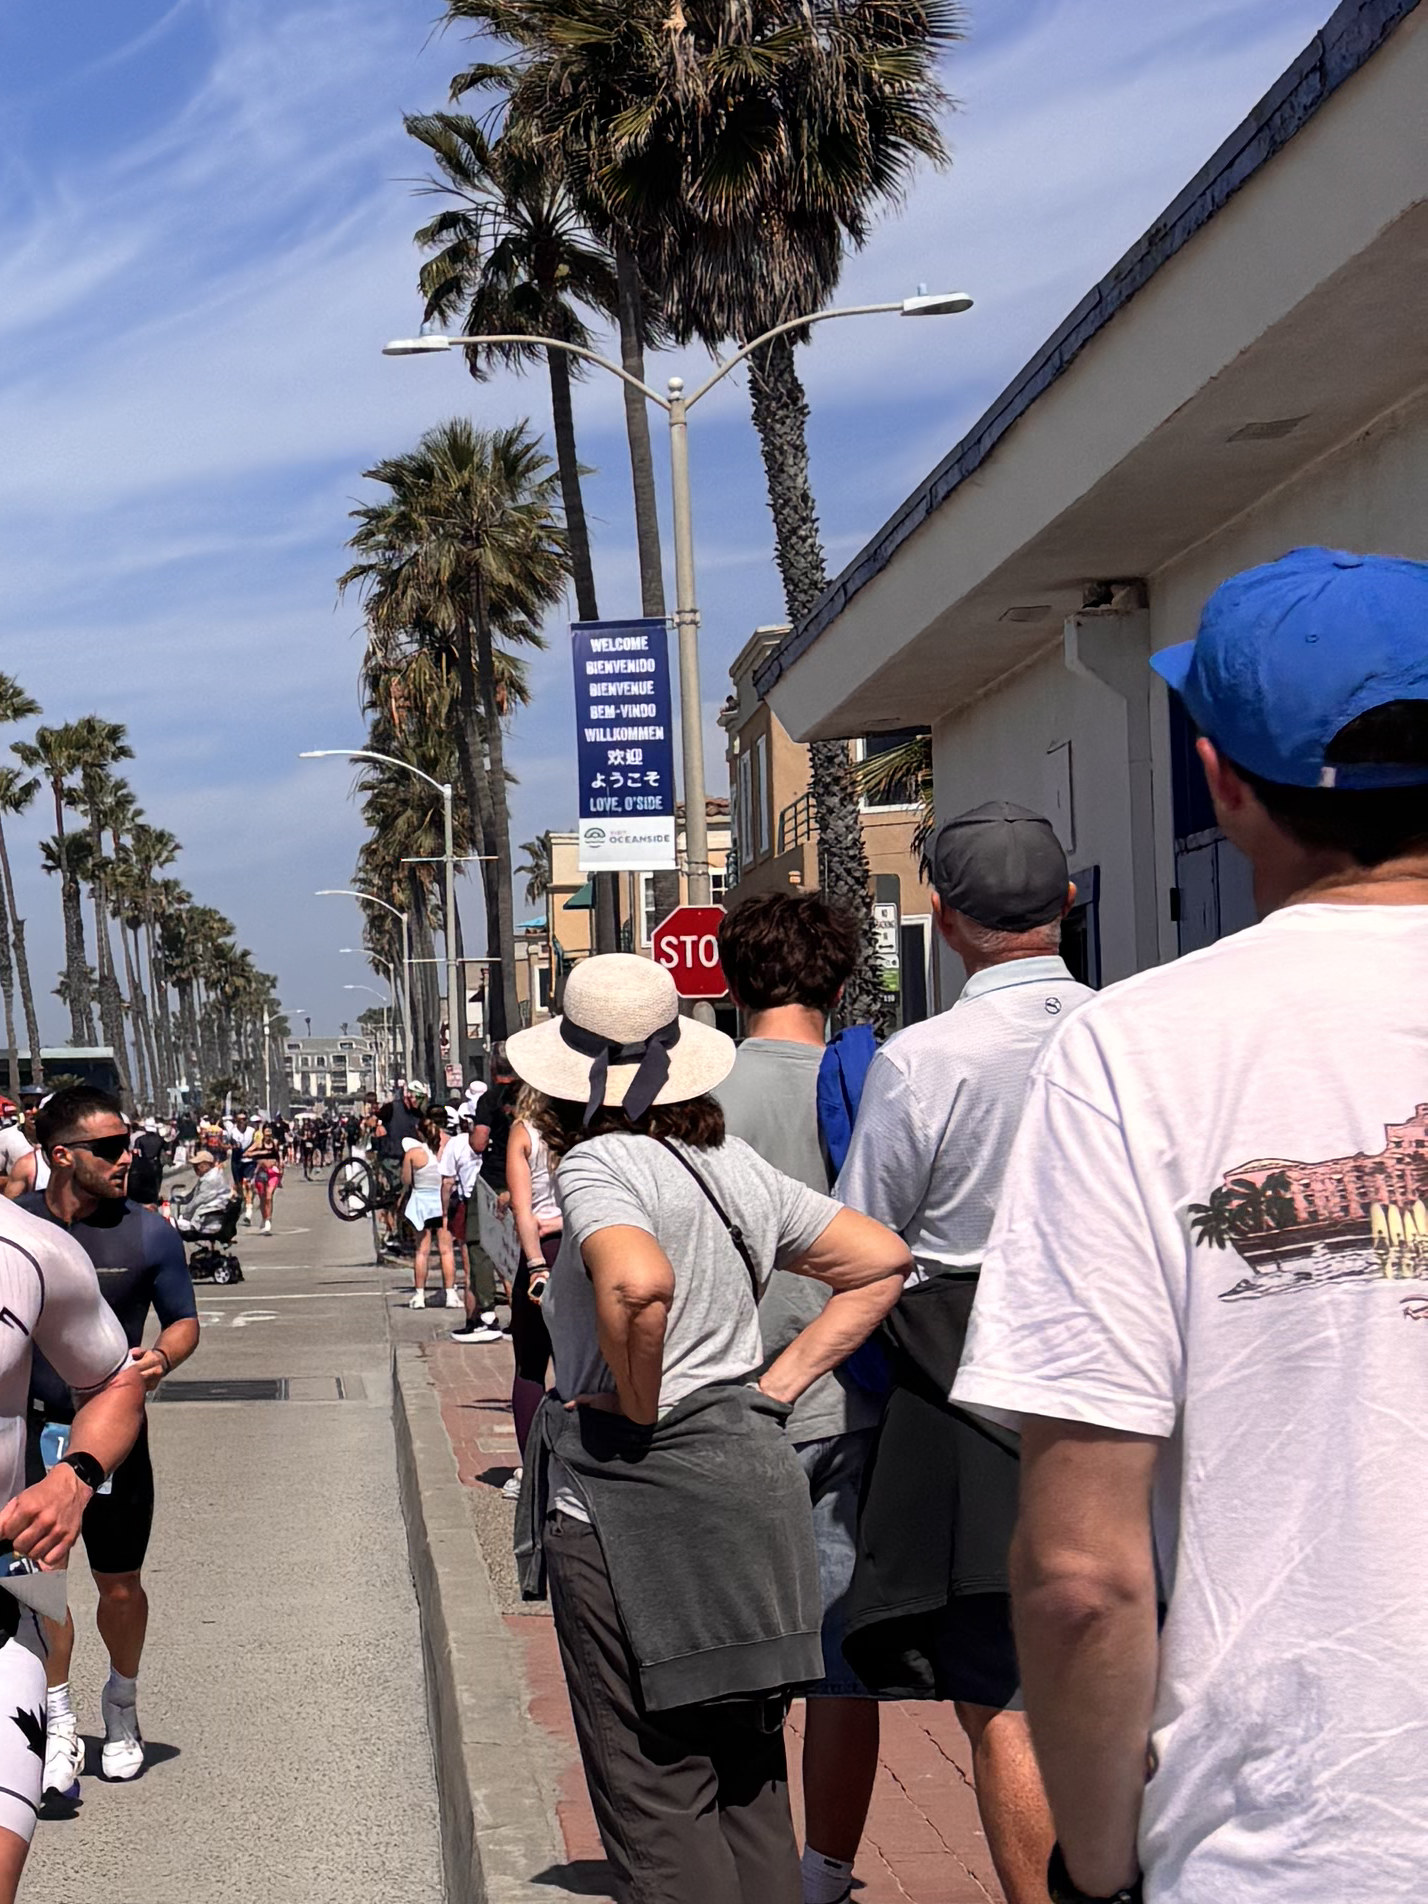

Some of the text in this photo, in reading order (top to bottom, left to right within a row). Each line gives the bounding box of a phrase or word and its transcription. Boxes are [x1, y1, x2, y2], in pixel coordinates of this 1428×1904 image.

[590, 636, 649, 653] WELCOME
[586, 658, 656, 675] BIENVENIDO
[589, 680, 655, 697] BIENVENUE
[590, 703, 657, 719] BEM-VINDO
[584, 726, 664, 742] WILLKOMMEN
[607, 748, 643, 765] 欢迎
[591, 771, 661, 789] ようこそ
[590, 796, 663, 812] LOVE, O'SIDE
[609, 834, 671, 844] OCEANSIDE
[660, 934, 719, 969] STO
